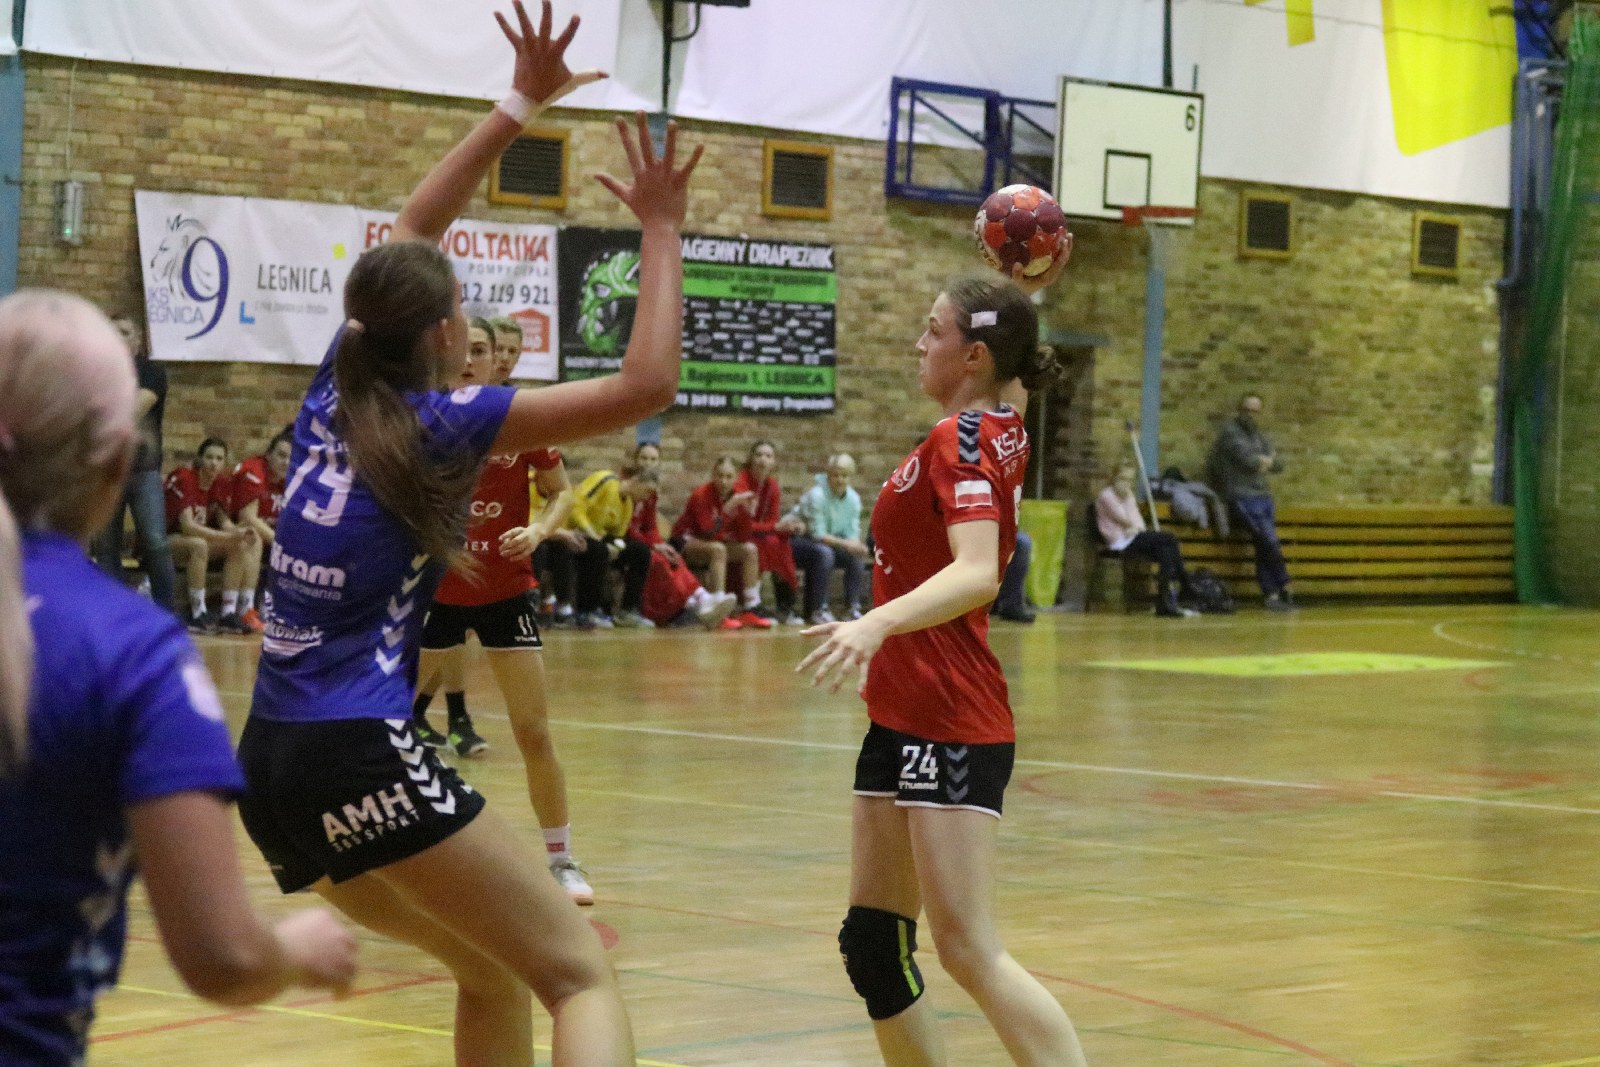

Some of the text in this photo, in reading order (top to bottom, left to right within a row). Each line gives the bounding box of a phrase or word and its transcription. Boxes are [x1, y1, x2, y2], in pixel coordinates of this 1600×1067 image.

[1185, 103, 1196, 132] 6
[365, 221, 550, 262] FOVOLTAIKA
[181, 236, 229, 340] 9
[256, 263, 332, 294] LEGNICA
[462, 282, 550, 305] 12 119 921
[147, 305, 206, 325] EGNICA
[900, 743, 939, 780] 24
[322, 782, 415, 843] AMH
